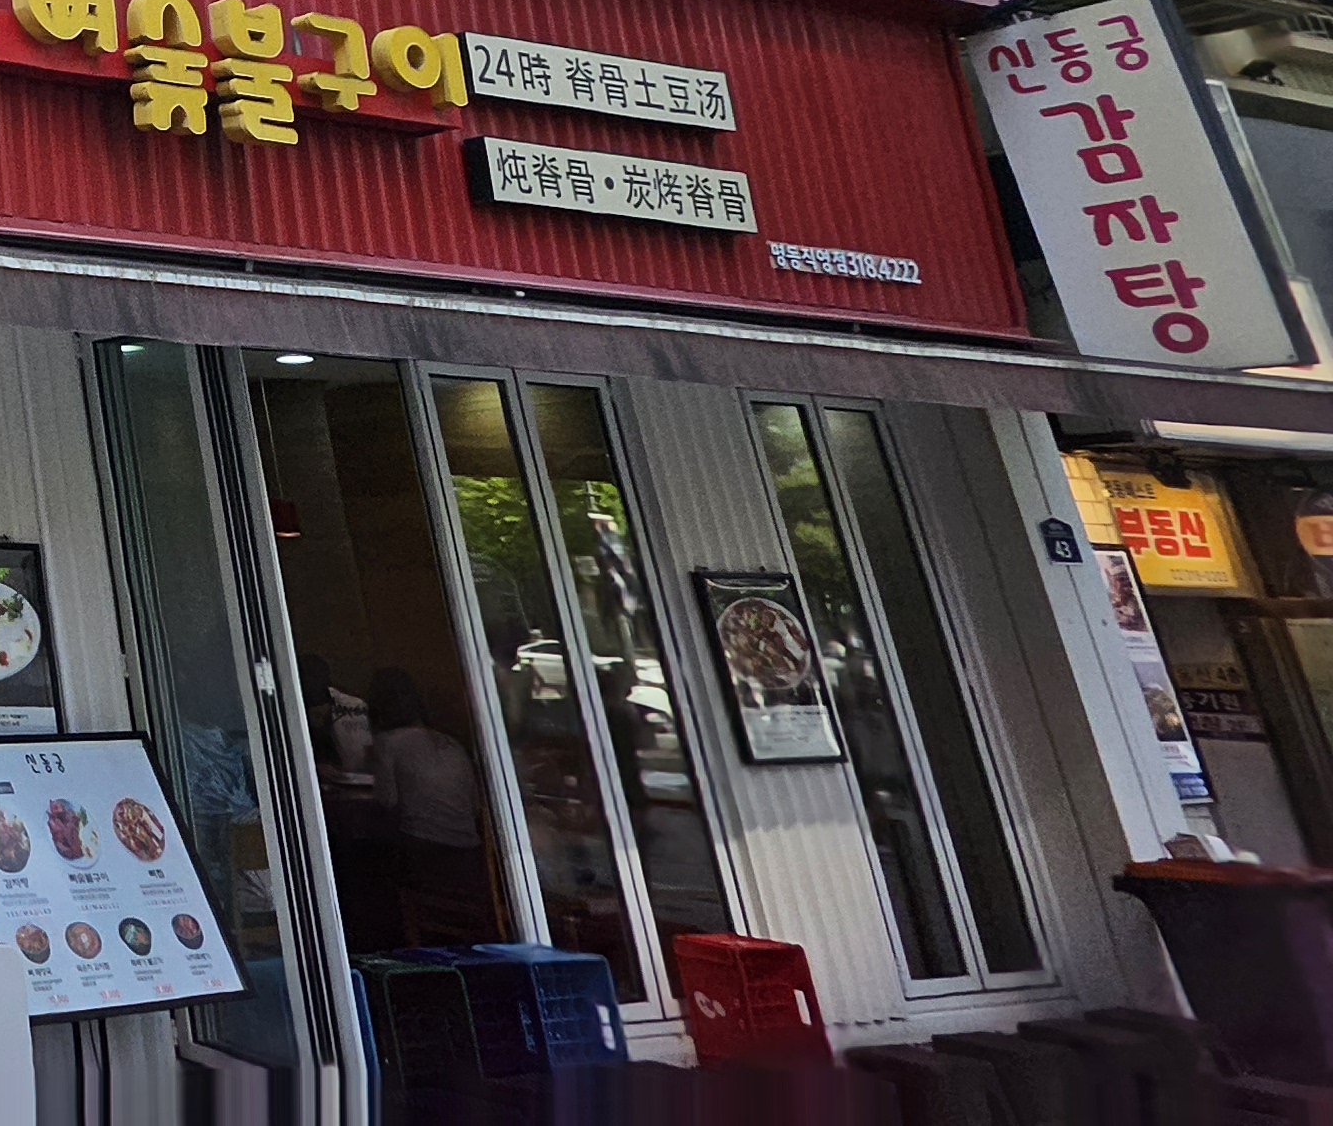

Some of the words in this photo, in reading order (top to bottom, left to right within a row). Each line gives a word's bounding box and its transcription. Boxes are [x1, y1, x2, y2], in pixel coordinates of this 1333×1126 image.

[474, 43, 552, 97] 24時
[565, 56, 728, 123] 脊骨土豆汤
[987, 14, 1150, 96] 신동궁
[1038, 93, 1211, 354] 감자탕
[1055, 540, 1072, 559] 43
[1114, 506, 1212, 560] 부동산
[24, 752, 66, 774] 신동궁
